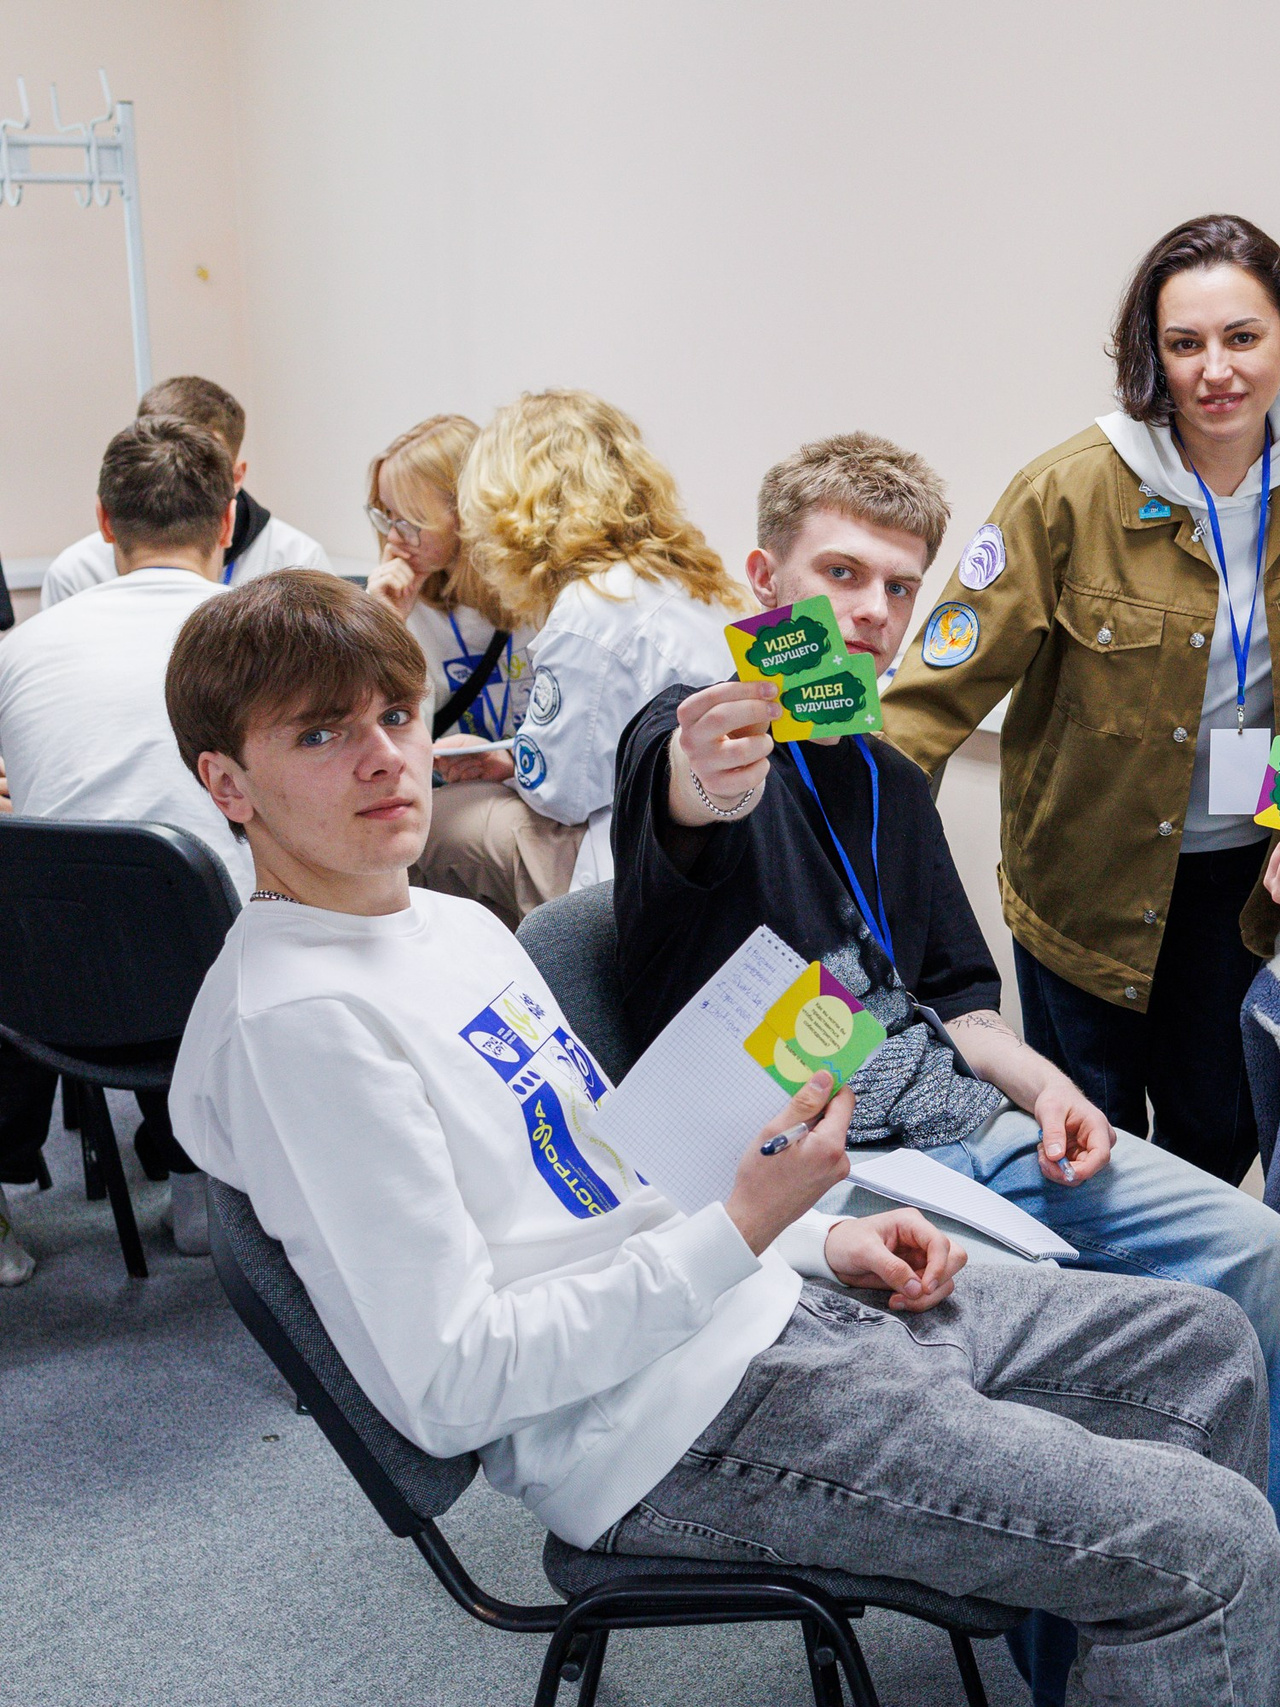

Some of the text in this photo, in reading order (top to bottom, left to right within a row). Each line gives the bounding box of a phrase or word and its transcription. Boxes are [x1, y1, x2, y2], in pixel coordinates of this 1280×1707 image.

[763, 629, 807, 653] ИДЕЯ
[761, 642, 819, 667] БУДУЩЕГО
[800, 682, 843, 700] ИДЕЯ
[794, 698, 854, 714] БУДУЩЕГО
